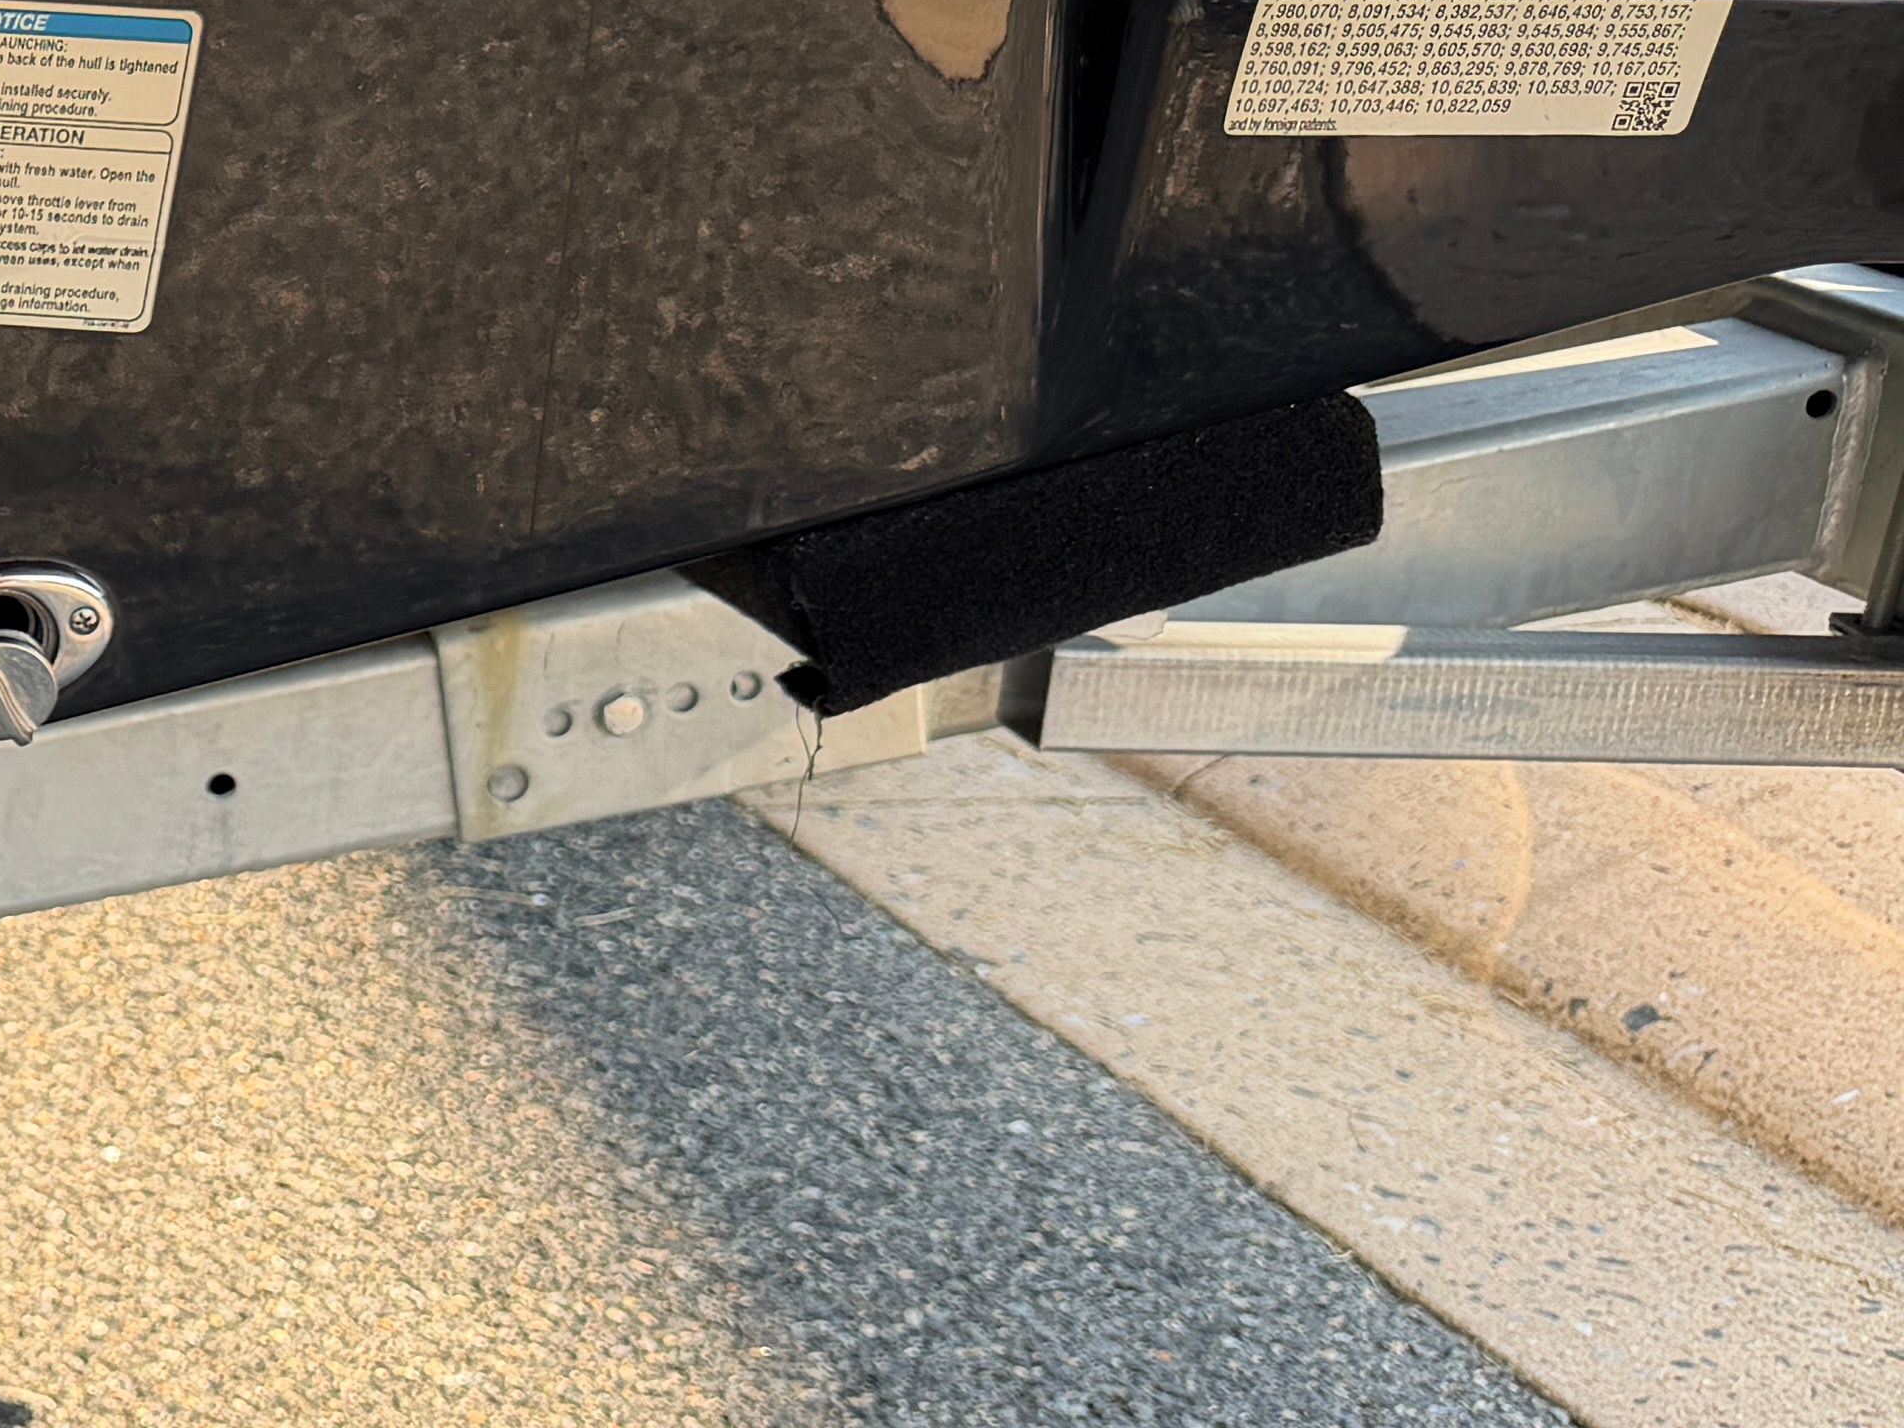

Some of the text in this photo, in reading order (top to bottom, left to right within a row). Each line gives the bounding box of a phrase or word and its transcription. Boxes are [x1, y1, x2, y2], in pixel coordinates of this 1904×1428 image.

[1261, 4, 1692, 20] 7,980,070; 8,091,534; 8,382,537; 8,646,430; 8,753,157;
[1255, 22, 1685, 39] 8,998,661; 9,505,475; 9,545,983; 9,545,984; 9,555,867;
[1249, 41, 1678, 58] 9,598,162; 9,599,063; 9,605,570; 9,630,698; 9,745,945;
[8, 52, 37, 65] back
[40, 54, 53, 67] of
[56, 55, 75, 68] the
[79, 56, 102, 69] hull
[105, 57, 115, 70] is
[120, 58, 178, 74] tightened
[1244, 60, 1680, 77] 9,760,091; 9,796,452; 9,863,295; 9,878,769; 10,167,057;
[1, 82, 54, 97] installed
[57, 88, 111, 103] securely.
[1241, 79, 1617, 96] 10,100,724; 10,647,388; 10,625,839; 10,583,907;
[31, 102, 97, 119] procedure.
[1236, 98, 1511, 114] 10,697,463; 10,703,446; 10,822,059
[1228, 117, 1248, 130] and
[1248, 117, 1261, 132] by
[25, 163, 55, 176] fresh
[60, 167, 95, 178] water.
[100, 168, 132, 183] Open
[136, 170, 155, 182] the
[28, 194, 71, 208] throttle
[75, 197, 104, 210] lever
[108, 199, 136, 212] from
[13, 208, 44, 221] 10-15
[47, 211, 98, 224] seconds
[102, 214, 114, 225] to
[118, 215, 148, 227] drain
[29, 243, 56, 254] caps
[59, 243, 70, 253] to
[72, 243, 86, 254] let
[88, 246, 118, 255] water
[120, 247, 148, 258] drain.
[29, 257, 59, 267] uses,
[64, 257, 104, 271] except
[108, 260, 139, 271] when
[1, 282, 51, 299] draining
[54, 288, 119, 302] procedure,
[18, 298, 90, 312] information.
